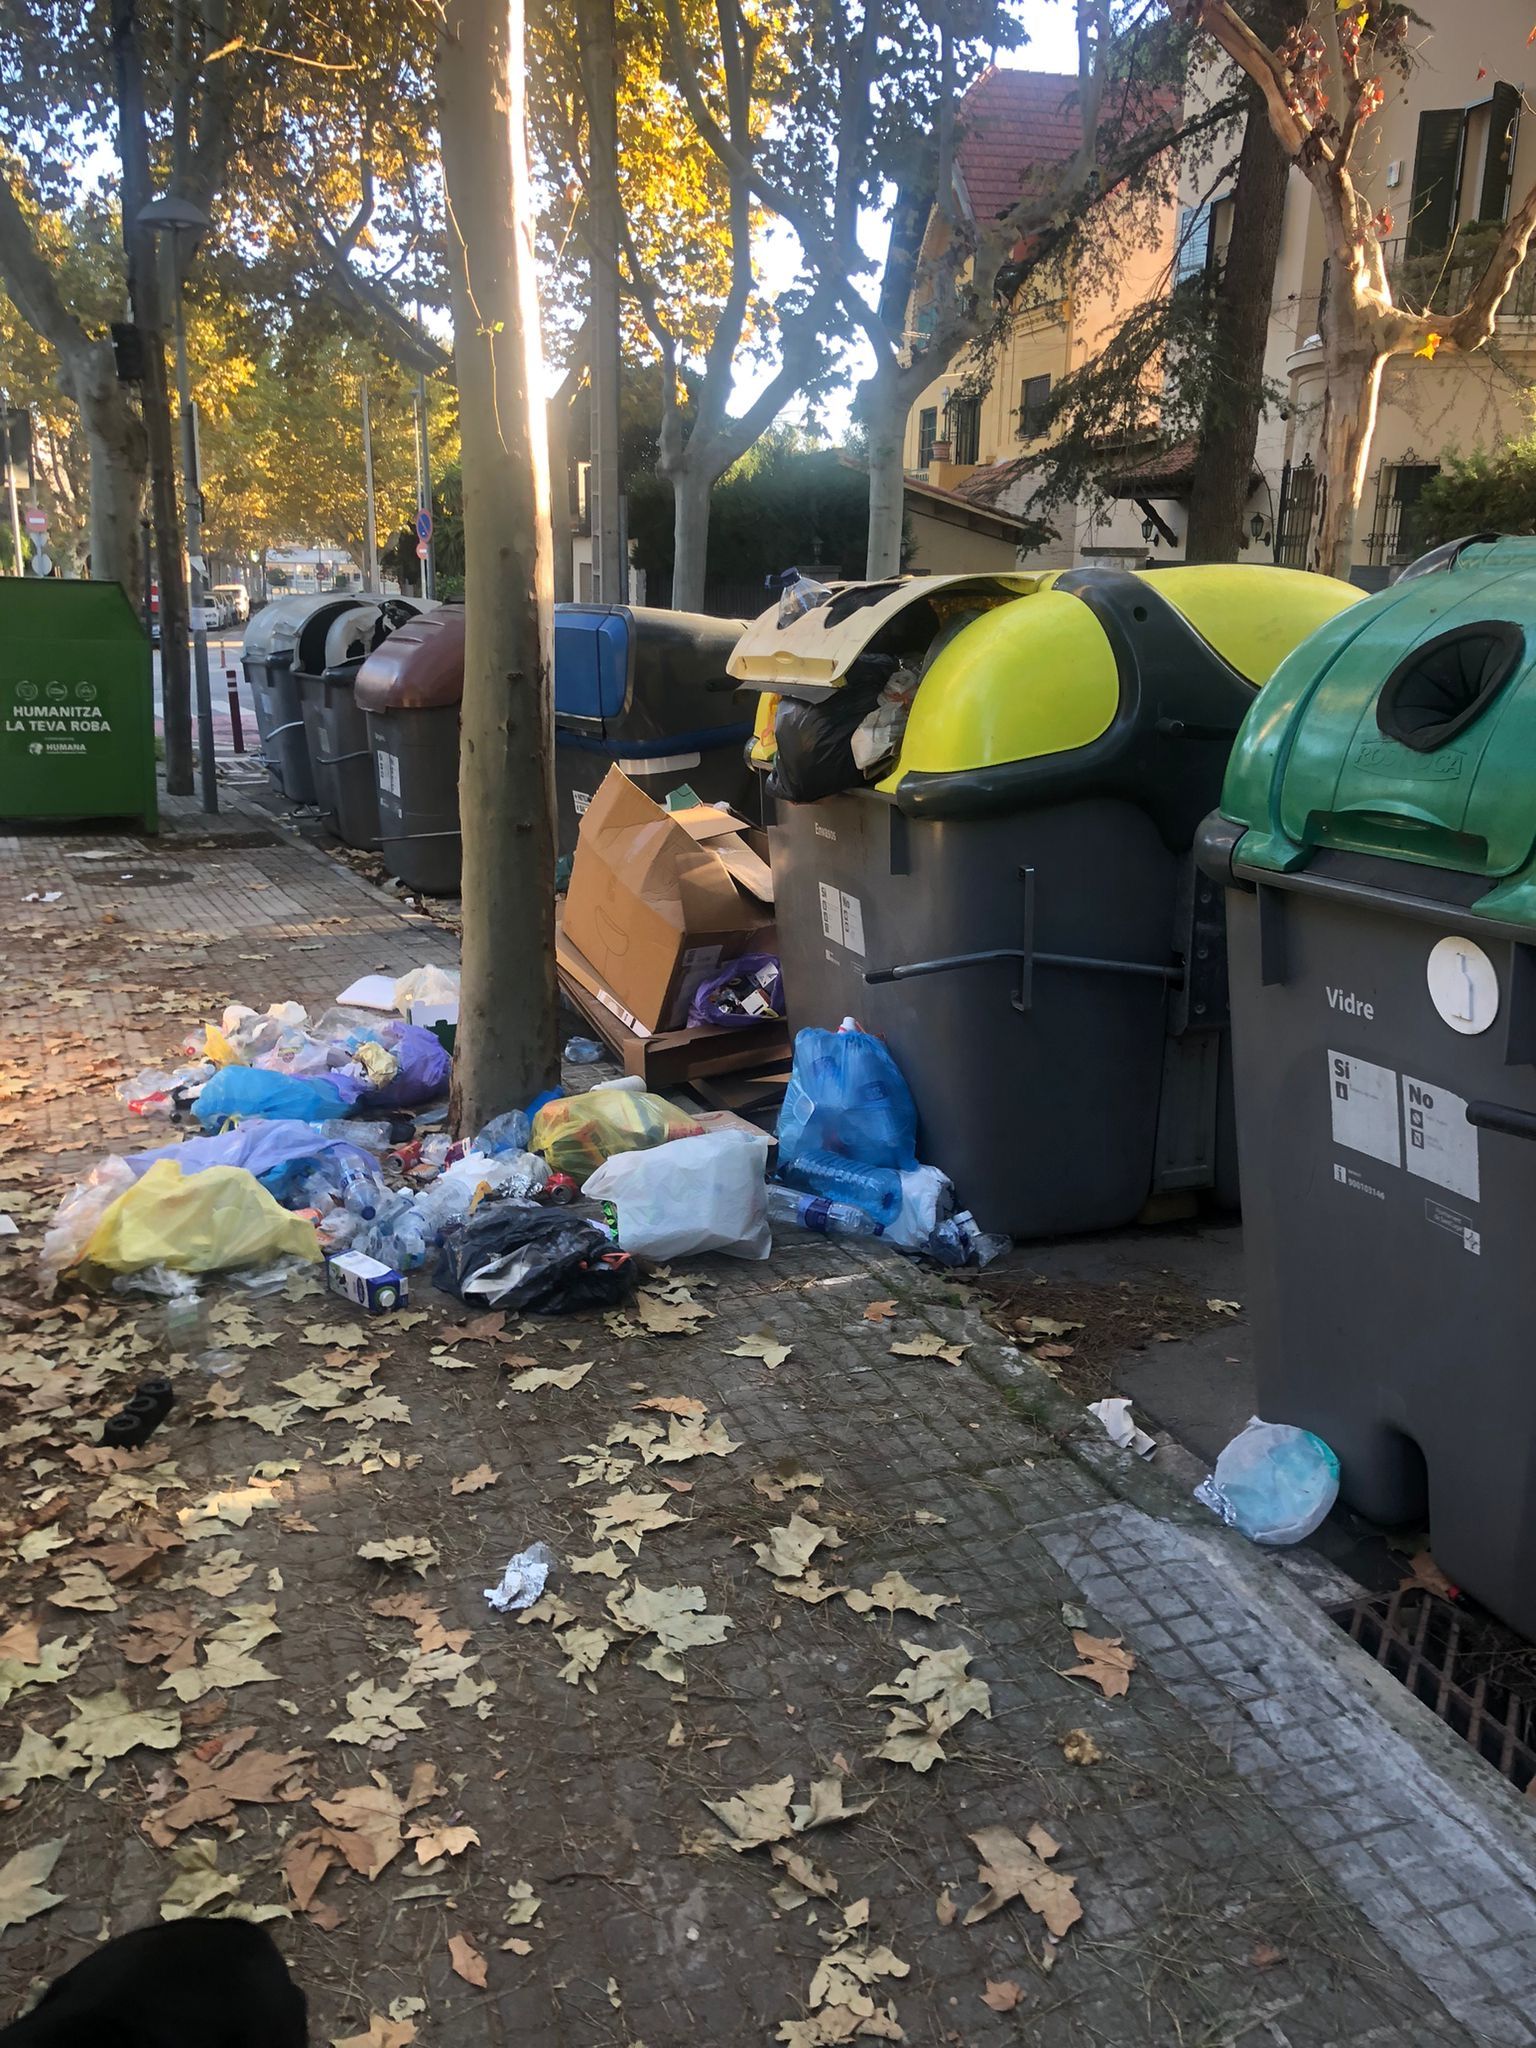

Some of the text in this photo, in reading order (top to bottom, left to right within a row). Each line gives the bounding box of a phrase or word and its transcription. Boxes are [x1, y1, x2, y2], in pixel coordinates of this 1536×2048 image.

[13, 706, 102, 717] HUMANITZA
[6, 720, 111, 732] LA TEVA ROBA
[46, 743, 87, 751] HUMANA
[1326, 986, 1374, 1020] Vidre
[1409, 1083, 1433, 1109] No
